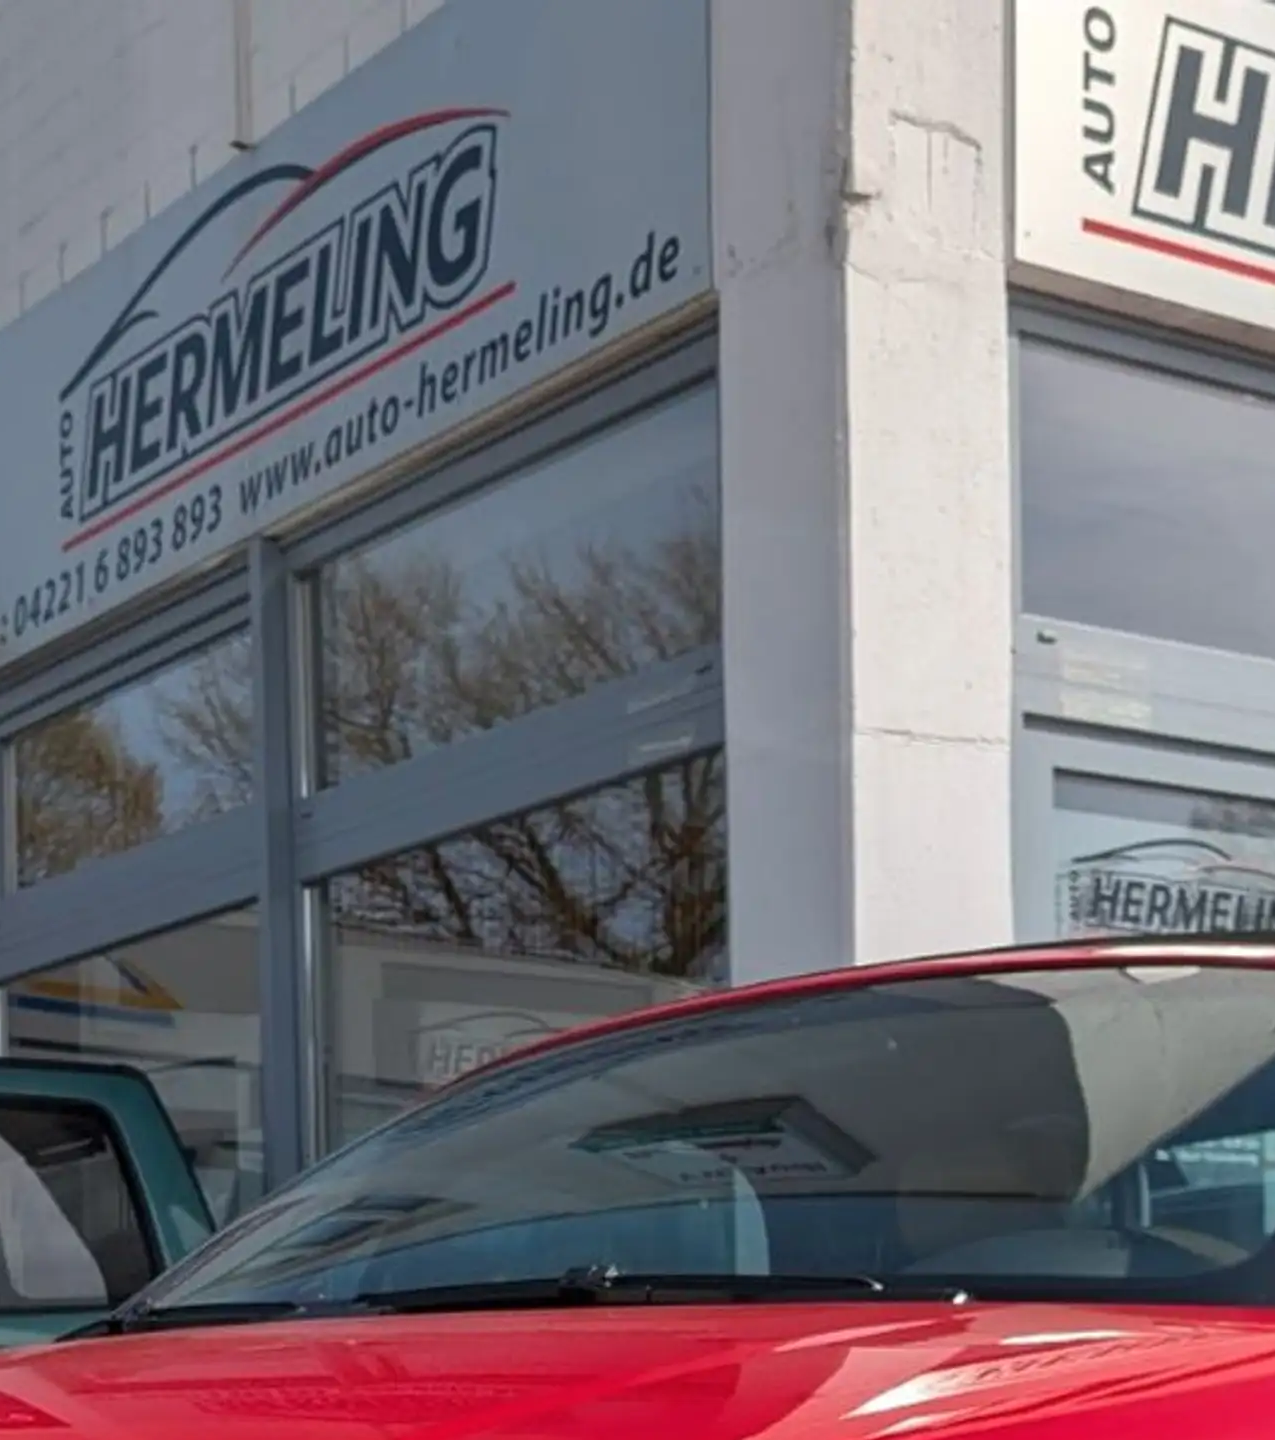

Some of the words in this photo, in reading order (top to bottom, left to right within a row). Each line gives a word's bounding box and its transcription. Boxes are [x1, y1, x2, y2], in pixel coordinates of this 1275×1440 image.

[1080, 5, 1118, 195] AUTO
[13, 561, 85, 638] 04221
[94, 549, 108, 593] 6
[115, 517, 163, 581] 893
[171, 484, 222, 552] 893
[237, 230, 681, 517] www.auto-hermeling.de
[85, 142, 486, 502] HERMELING
[59, 408, 75, 520] AUTO
